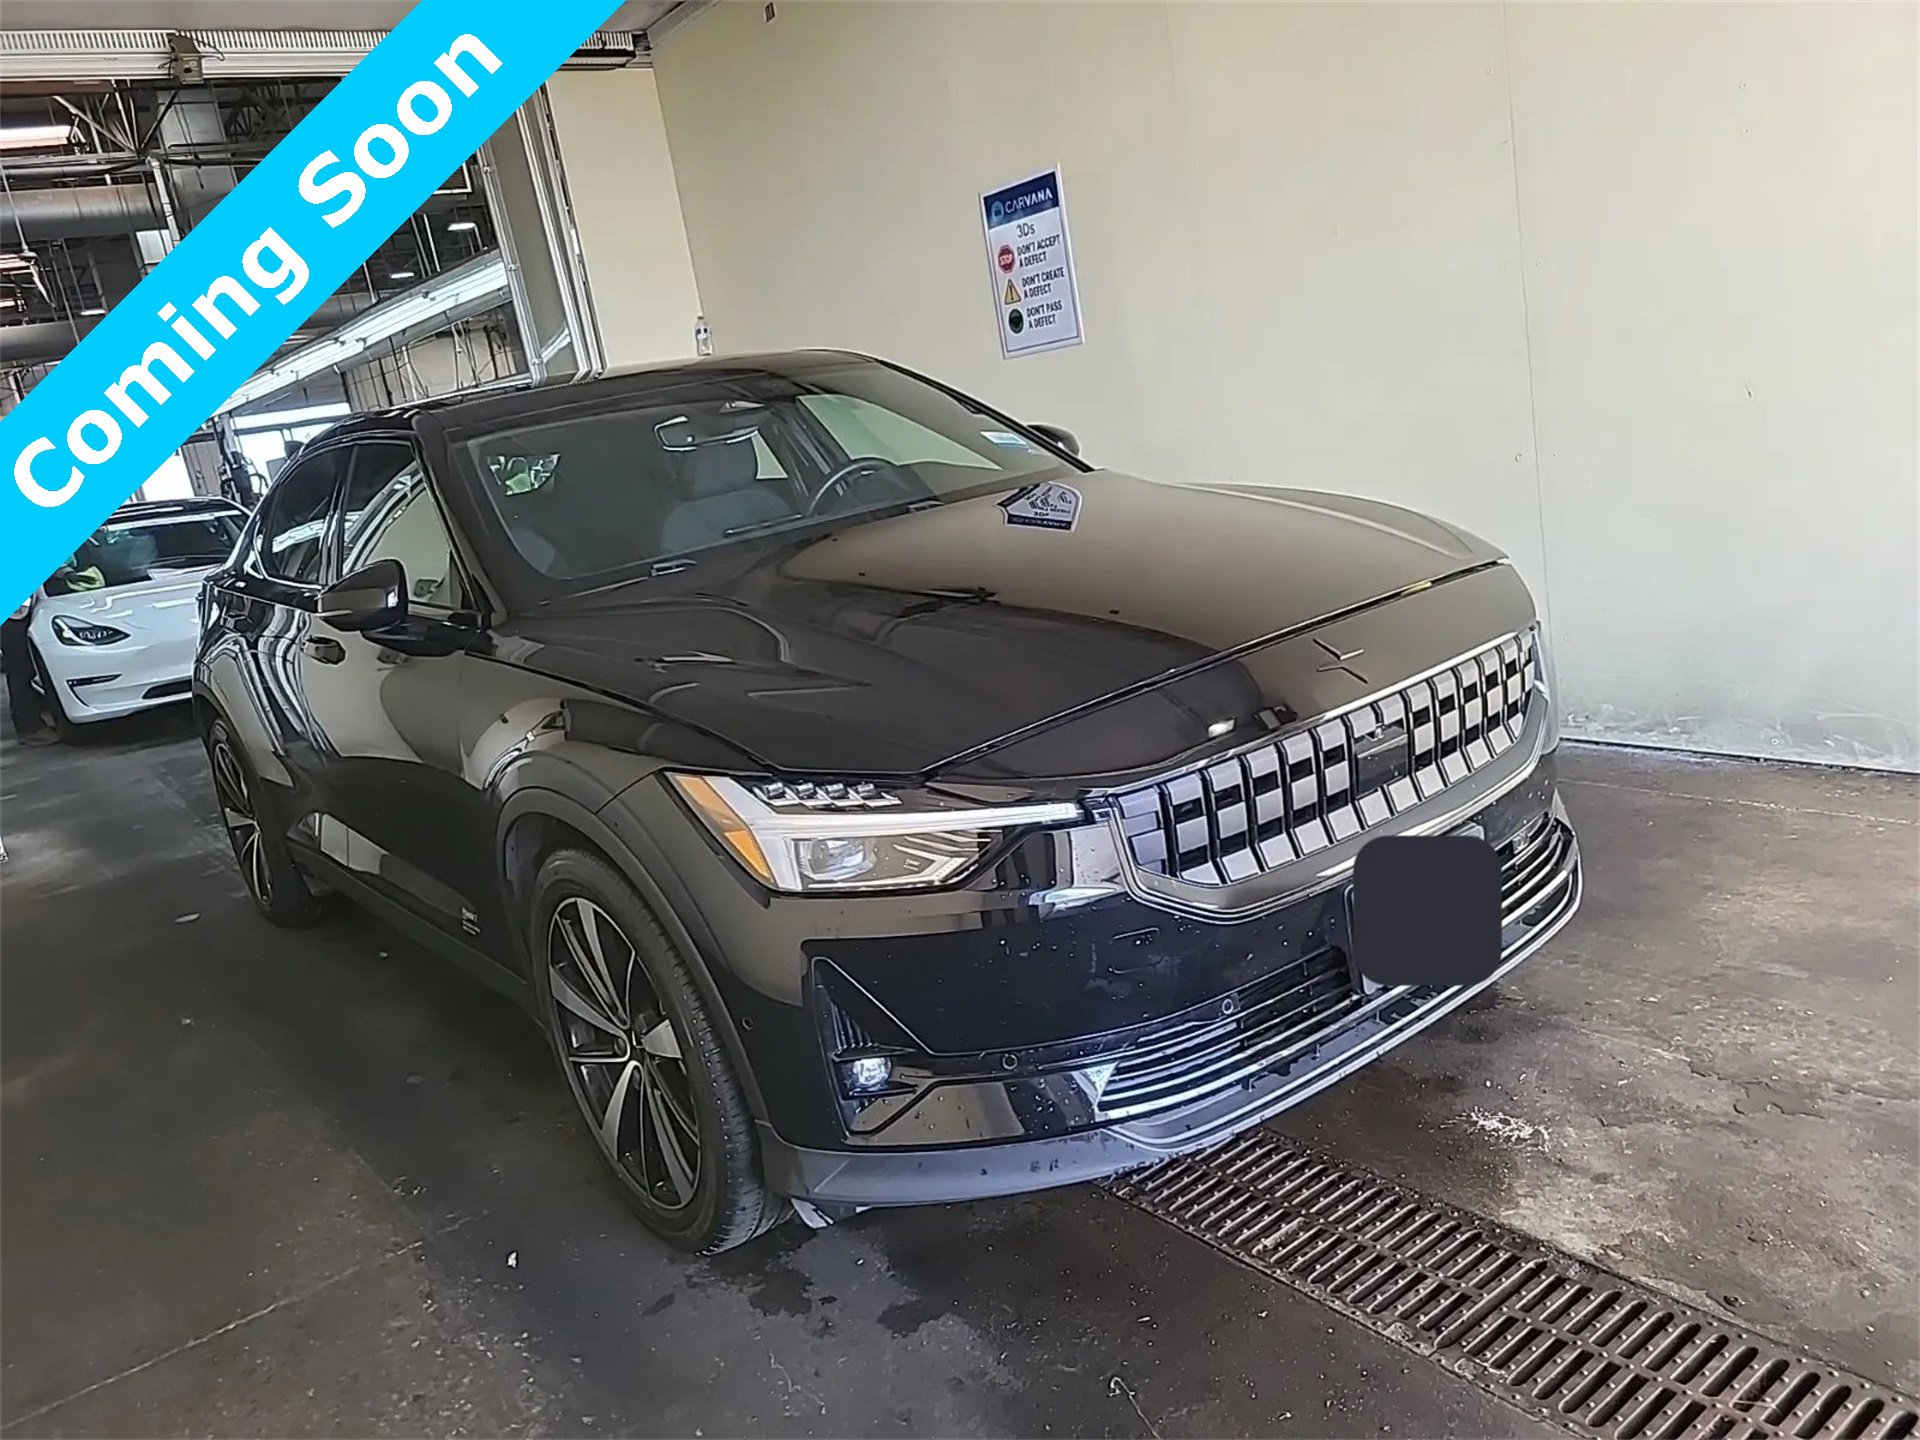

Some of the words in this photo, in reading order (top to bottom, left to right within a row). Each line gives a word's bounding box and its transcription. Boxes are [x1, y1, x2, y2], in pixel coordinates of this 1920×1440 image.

[1004, 187, 1053, 214] CARVANA
[1016, 222, 1036, 239] 3Ds
[1016, 241, 1036, 257] DON'T
[1037, 233, 1060, 251] ACCEPT
[1024, 250, 1047, 267] DEFECT
[1021, 273, 1041, 288] DON'T
[1041, 266, 1065, 282] CREATE
[1029, 282, 1052, 298] DEFECT
[1026, 303, 1045, 318] DON'T
[1045, 299, 1063, 314] PASS
[1033, 313, 1056, 329] DEFECT
